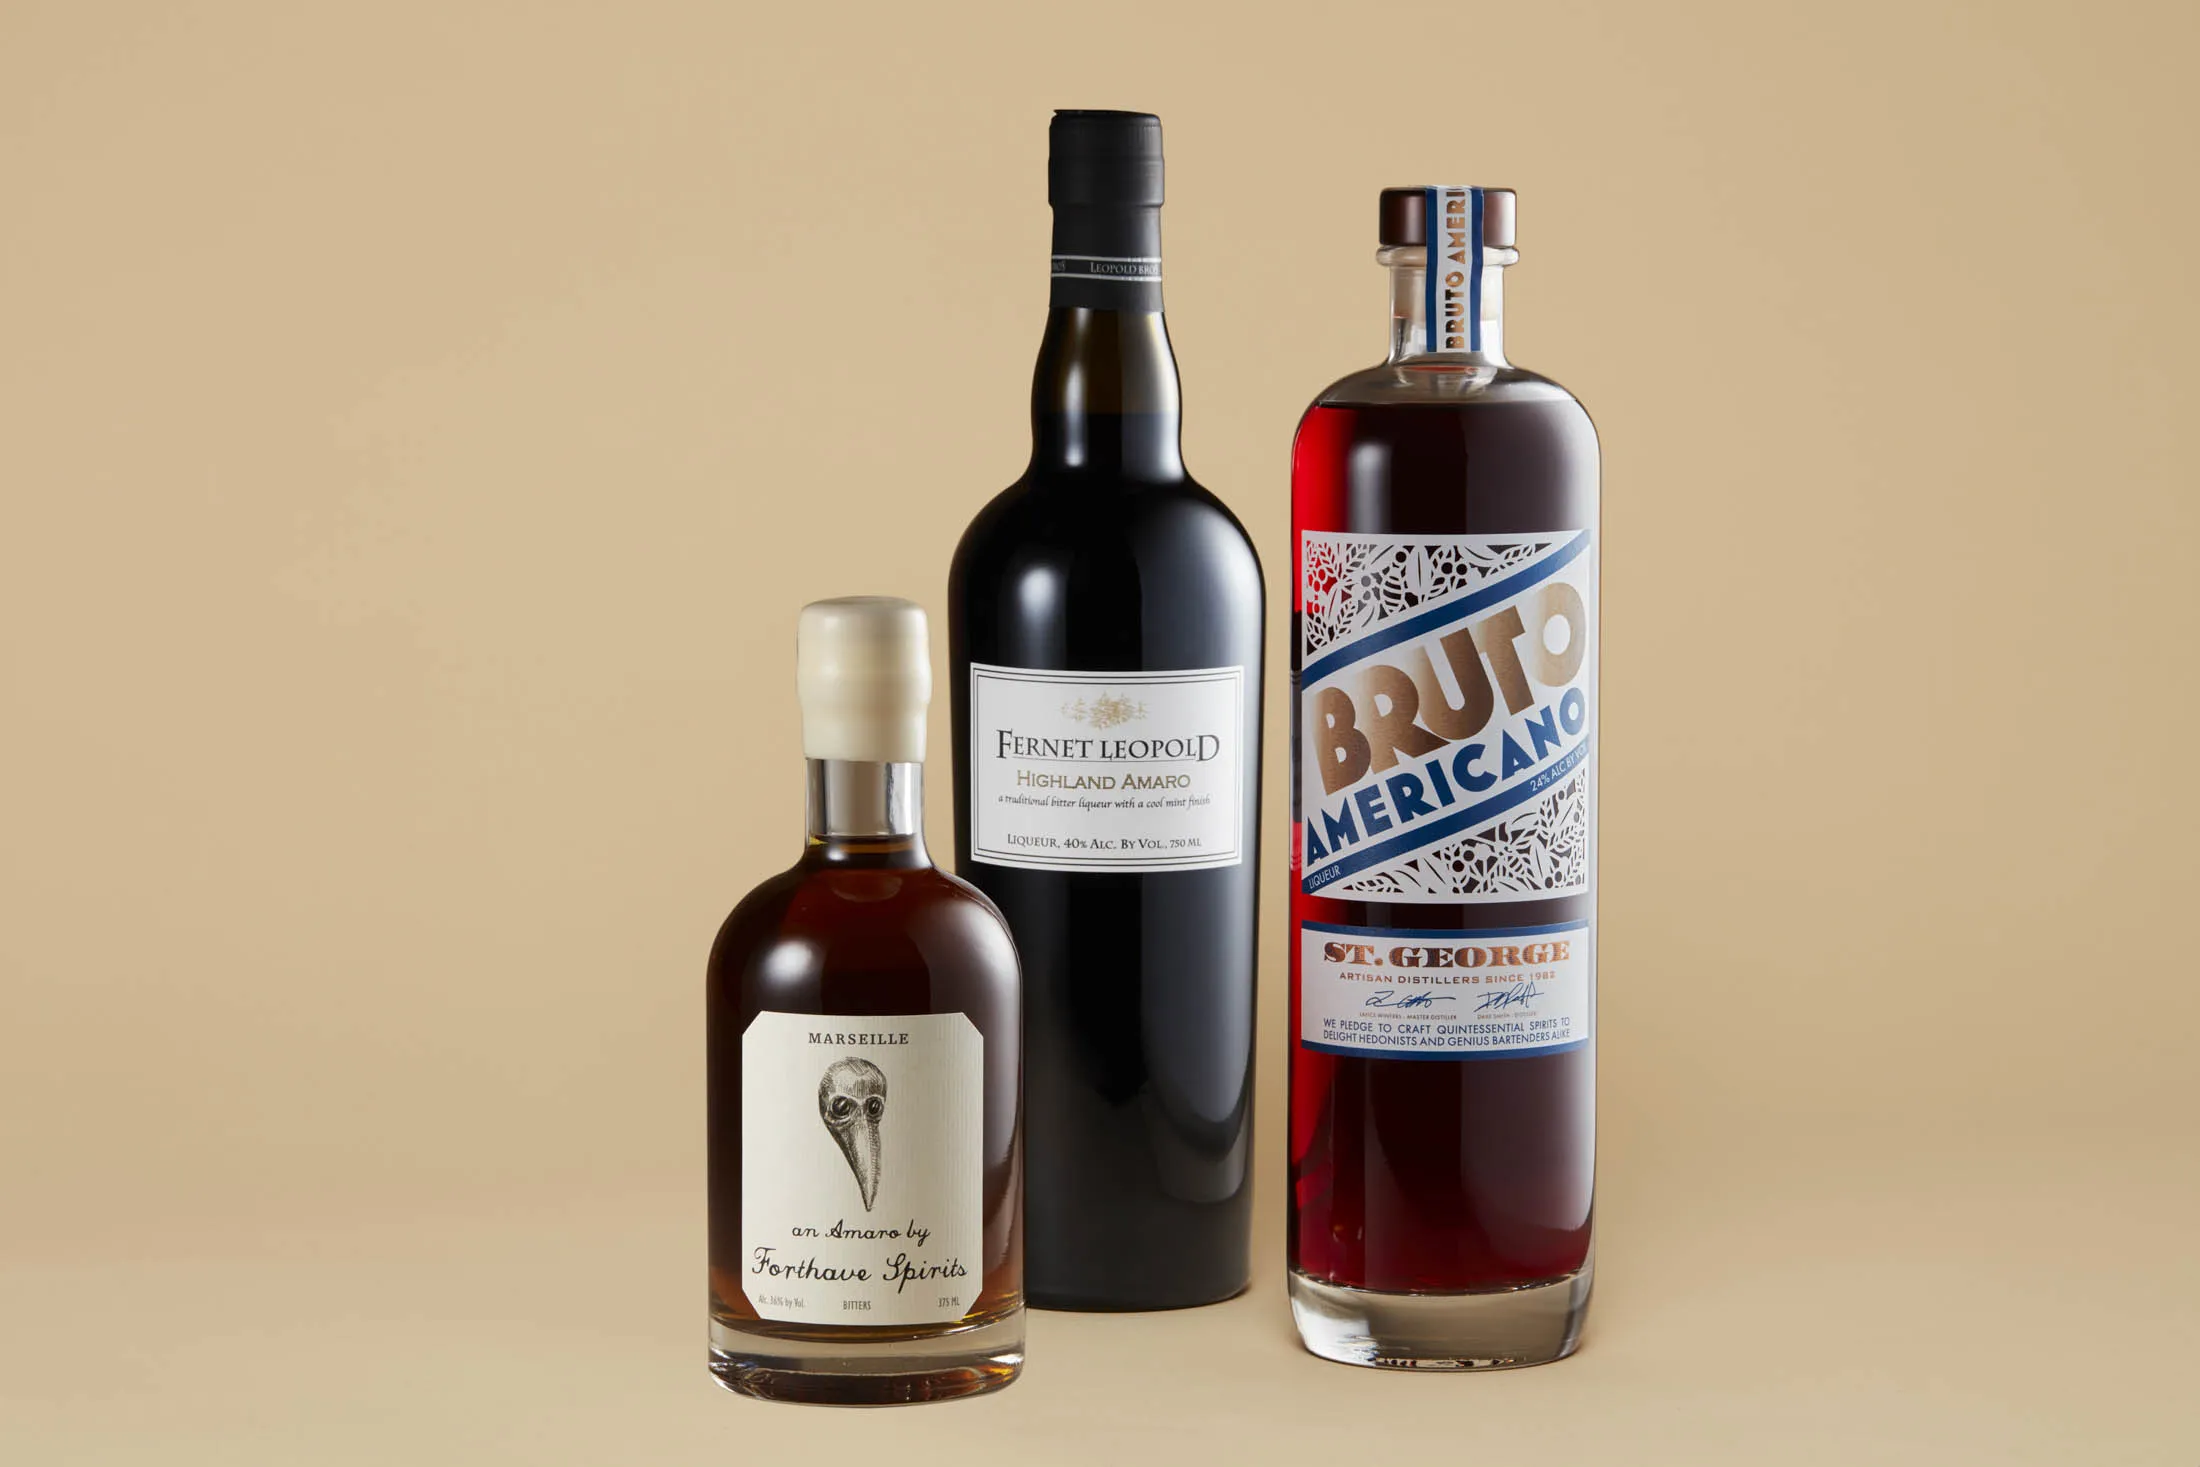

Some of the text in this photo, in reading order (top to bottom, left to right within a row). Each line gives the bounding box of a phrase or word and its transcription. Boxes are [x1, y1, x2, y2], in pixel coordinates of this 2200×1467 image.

[1090, 261, 1136, 274] LEOPOLD
[1445, 271, 1465, 348] BRUTO
[1311, 582, 1586, 796] BRUTO
[996, 728, 1220, 761] FERNET LEOPOLD
[1016, 770, 1191, 790] HIGHLAND AMARO
[1306, 687, 1586, 867] AMERICANO
[1530, 772, 1550, 792] 24%
[1551, 761, 1566, 780] ALC
[1005, 795, 1050, 806] traditional
[1051, 796, 1076, 808] bitter
[1078, 798, 1111, 812] liqueur
[1114, 798, 1135, 809] with
[1146, 798, 1163, 808] cool
[1165, 798, 1186, 807] mint
[1187, 795, 1211, 811] finish
[1064, 838, 1088, 849] 40%
[1169, 839, 1186, 848] 750
[1308, 865, 1341, 889] LIQUEUR
[1323, 940, 1570, 968] ST. GEORGE
[1339, 972, 1393, 983] ARTISAN
[1398, 975, 1480, 984] DISTILLERS
[1485, 974, 1525, 983] SINCE
[1323, 1016, 1570, 1035] WE PLEDGE TO CRAFT QUINTESSENTIAL SPIRITS TO
[808, 1032, 910, 1045] MARSEILLE
[1323, 1029, 1570, 1047] DELIGHT HEDONISTS AND GENIUS BARTENDERS ALIKE
[792, 1219, 931, 1247] an Amaro by
[751, 1246, 969, 1294] Forthave Spirits
[785, 1297, 793, 1309] by
[843, 1300, 872, 1311] BITTERS
[938, 1297, 950, 1308] 375
